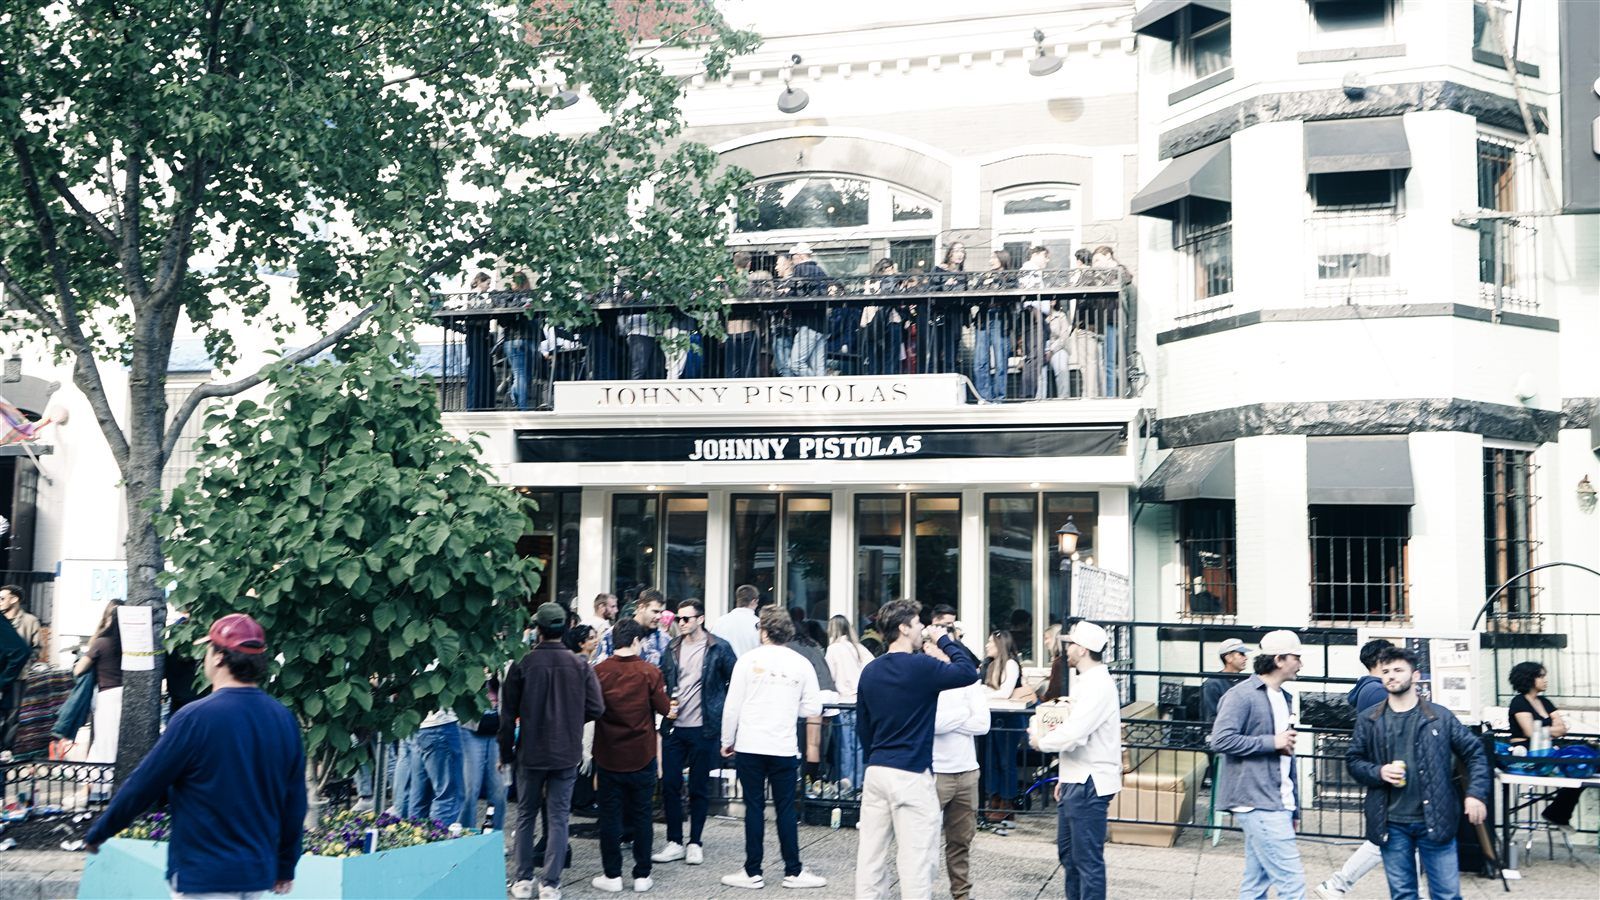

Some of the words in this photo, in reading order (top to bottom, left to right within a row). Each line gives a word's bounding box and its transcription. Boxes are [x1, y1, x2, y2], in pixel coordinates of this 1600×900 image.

[597, 387, 728, 405] JOHNNY
[744, 384, 908, 404] PISTOLAS
[688, 438, 789, 460] JOHNNY
[799, 435, 922, 459] PISTOLAS
